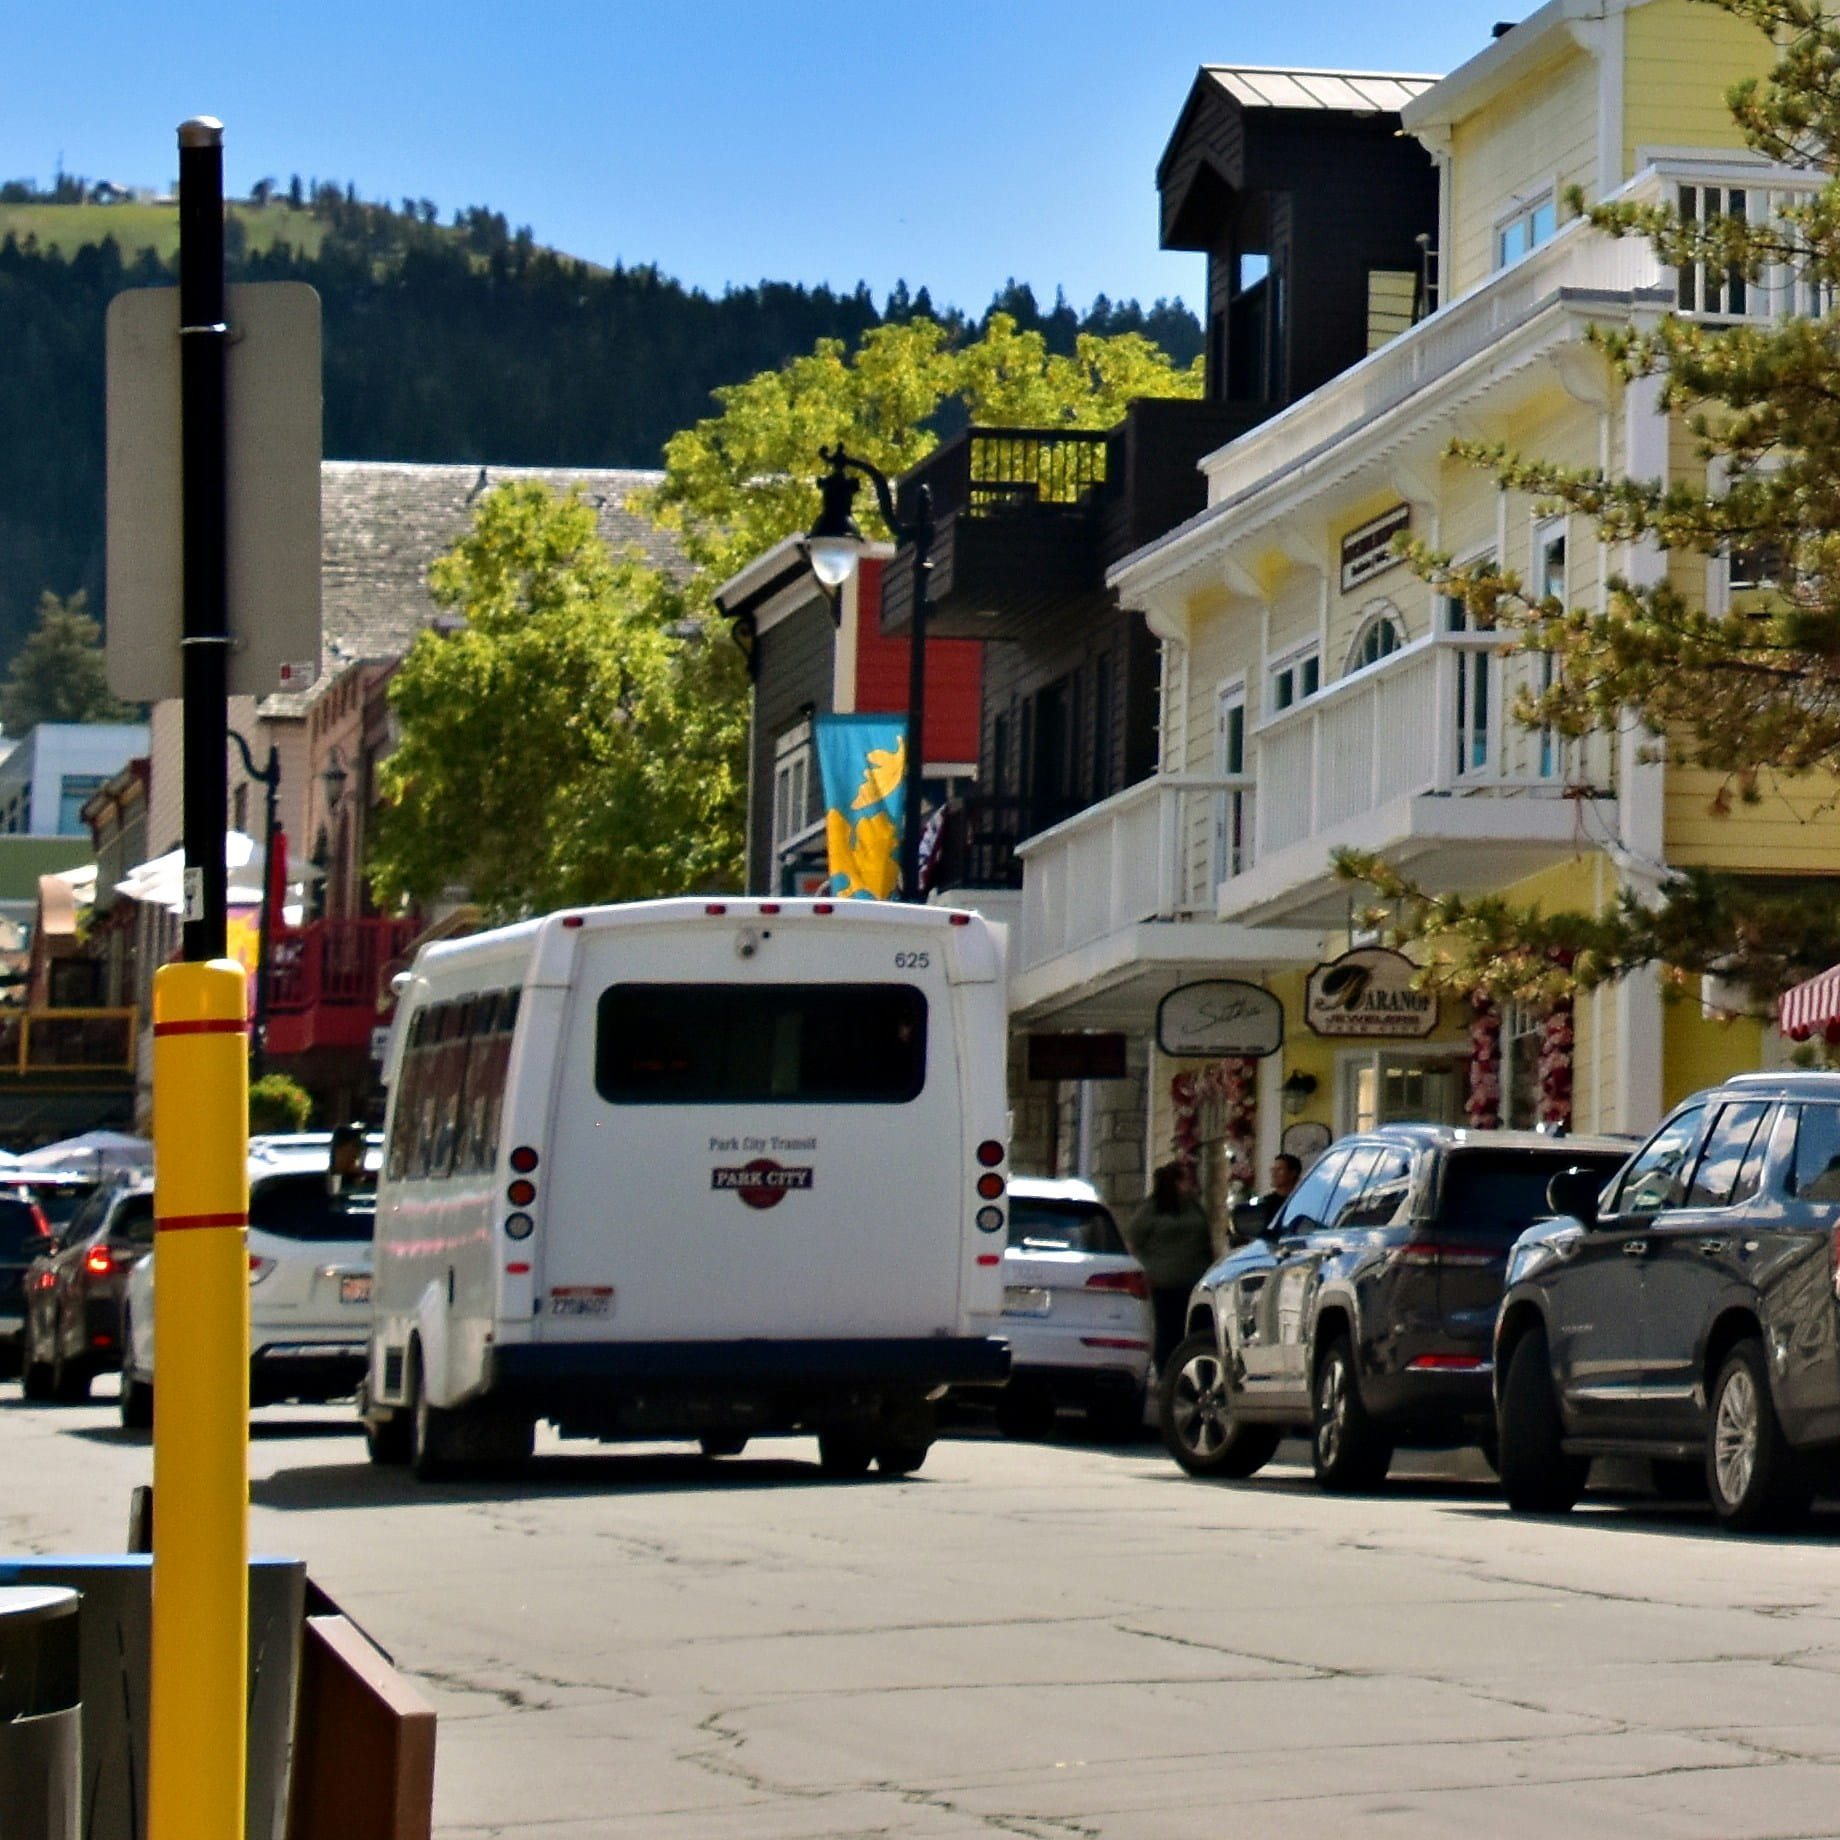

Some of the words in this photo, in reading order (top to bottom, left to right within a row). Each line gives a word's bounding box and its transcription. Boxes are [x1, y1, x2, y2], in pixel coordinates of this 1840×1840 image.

[894, 951, 930, 969] 625
[709, 1136, 739, 1152] Park
[742, 1136, 766, 1154] City
[769, 1135, 817, 1151] Transit
[717, 1170, 762, 1187] PARK
[767, 1170, 808, 1187] CITY
